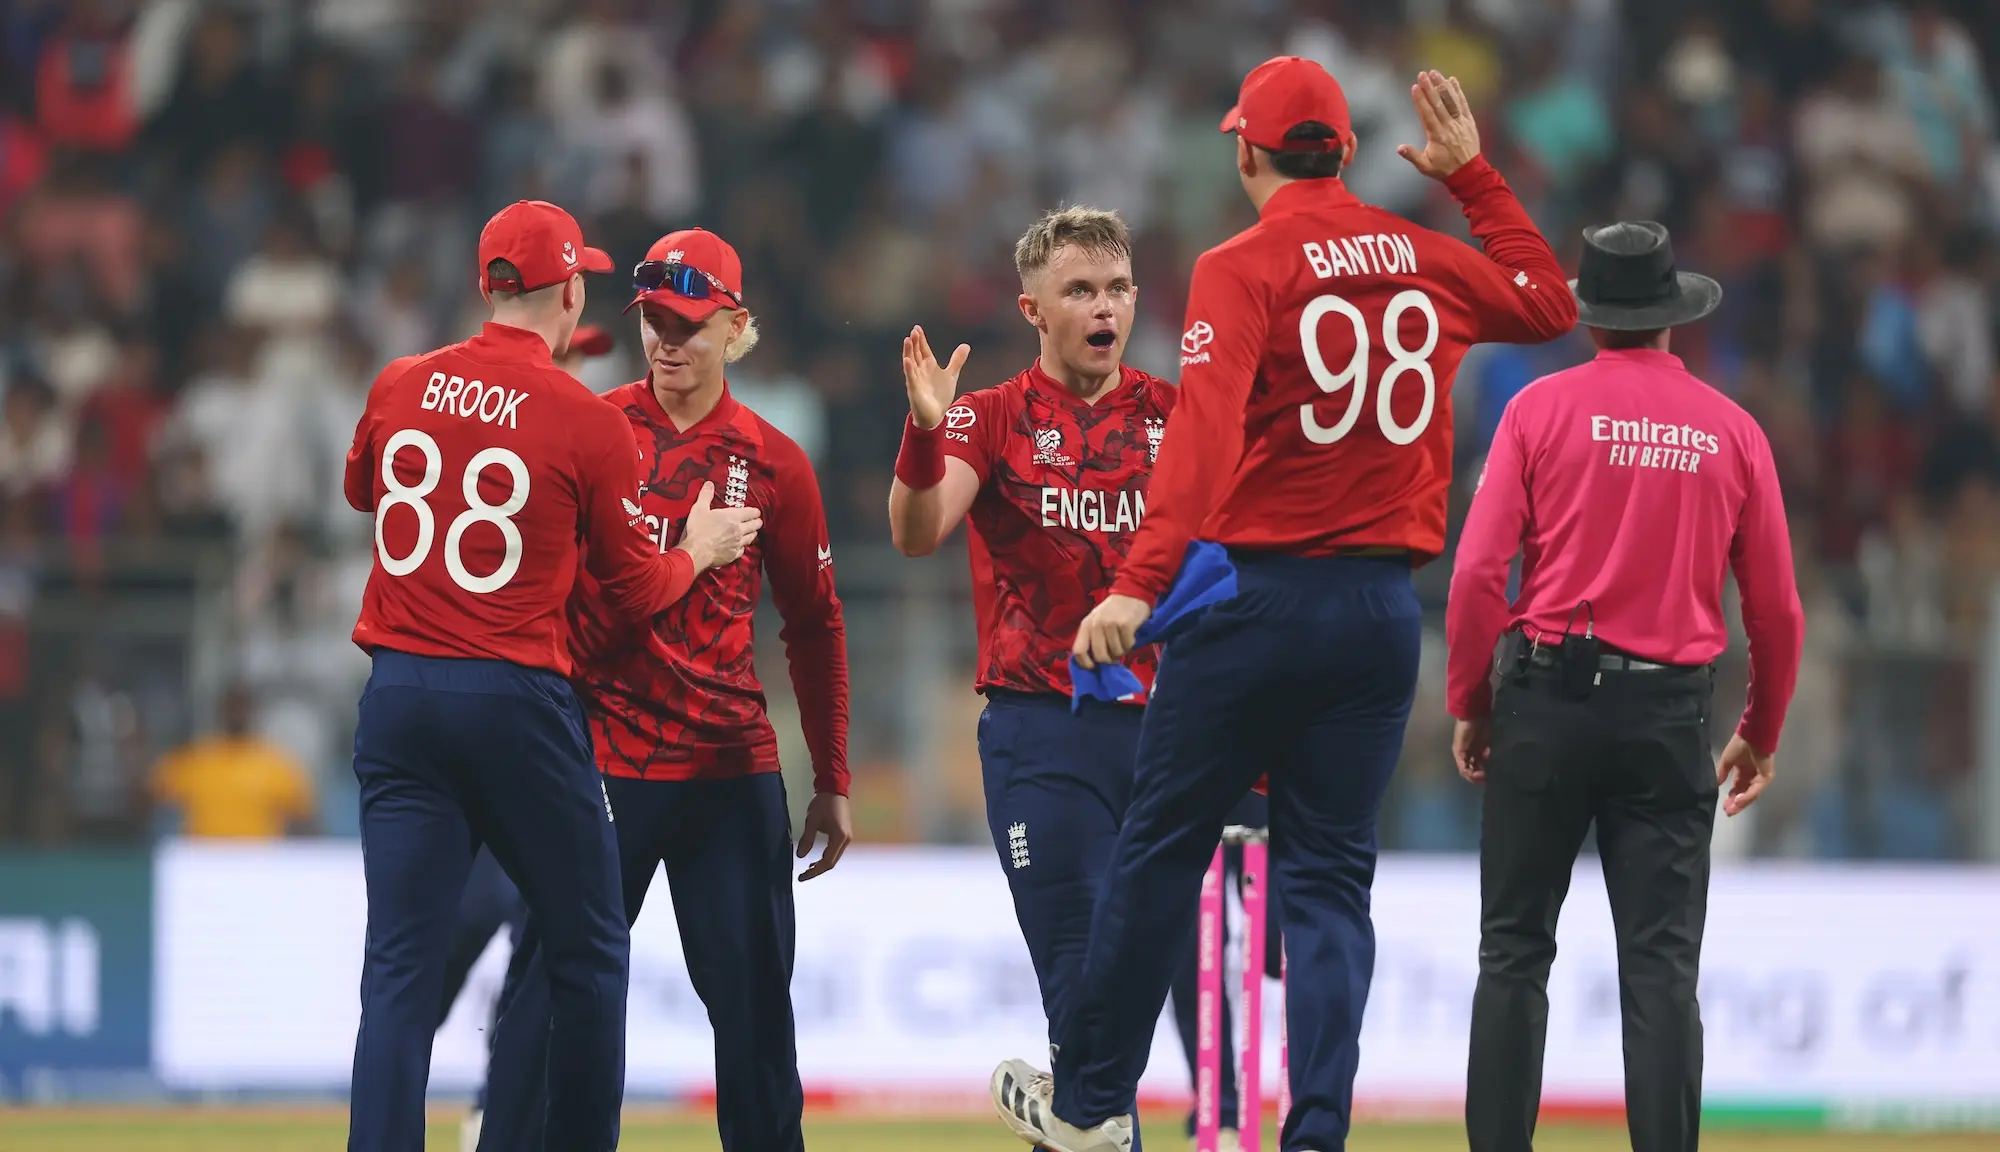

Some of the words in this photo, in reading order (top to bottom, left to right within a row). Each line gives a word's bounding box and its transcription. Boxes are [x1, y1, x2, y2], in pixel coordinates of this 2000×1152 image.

[1303, 233, 1417, 279] BANTON
[1299, 289, 1439, 446] 98
[420, 371, 530, 430] BROOK
[945, 430, 969, 444] OTA
[1591, 415, 1719, 455] Emirates
[1056, 455, 1070, 463] CUP
[1609, 444, 1637, 467] FLY
[1640, 445, 1701, 474] BETTER
[375, 428, 531, 594] 88
[1041, 487, 1146, 533] ENGLAN
